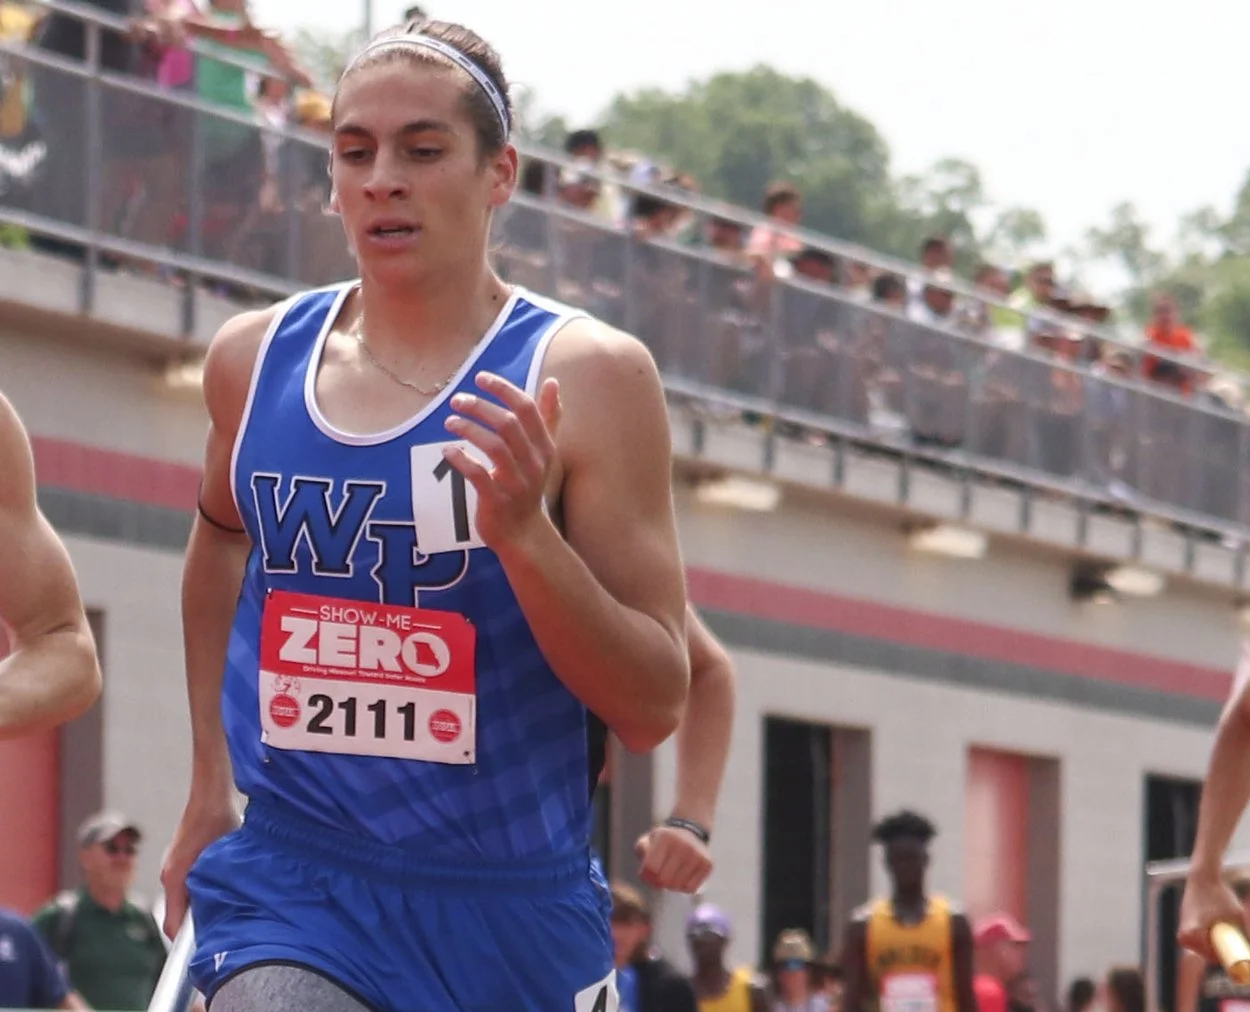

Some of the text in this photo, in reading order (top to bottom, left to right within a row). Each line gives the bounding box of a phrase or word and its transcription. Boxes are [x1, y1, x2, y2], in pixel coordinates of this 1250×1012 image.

[432, 447, 470, 543] 1
[319, 604, 412, 631] SHOW-ME
[279, 615, 451, 677] ZERO
[306, 693, 416, 742] 2111
